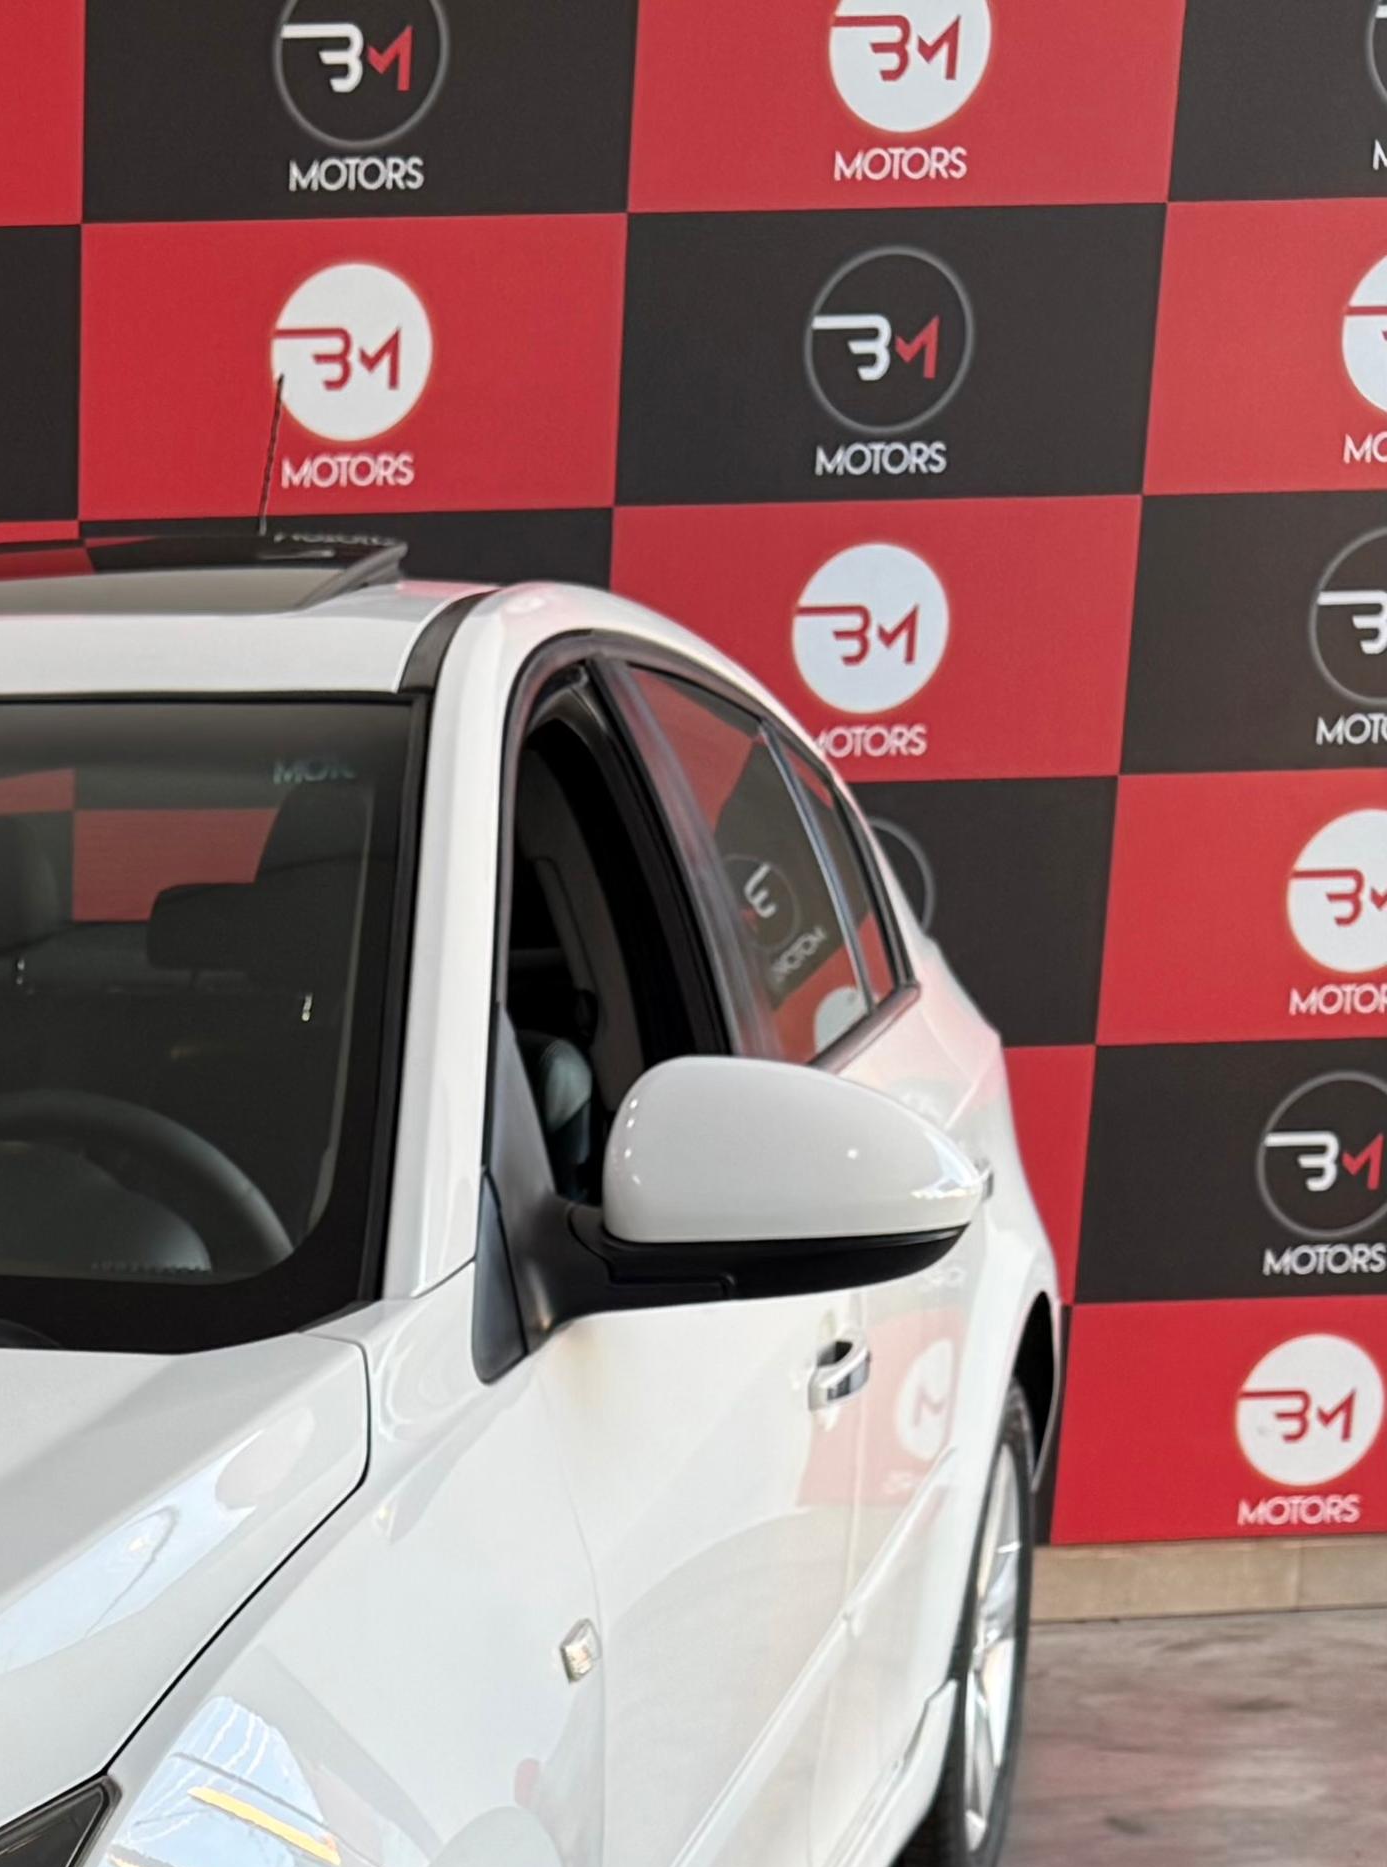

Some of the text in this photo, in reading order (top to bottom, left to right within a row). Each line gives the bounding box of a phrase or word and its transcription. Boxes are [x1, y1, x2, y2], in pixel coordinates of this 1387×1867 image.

[288, 157, 424, 193] MOTORS
[833, 146, 968, 182] MOTORS
[281, 453, 414, 490] MOTORS
[815, 441, 947, 476] MOTORS
[1317, 590, 1387, 654] B
[1316, 713, 1387, 745] MOT
[1289, 983, 1387, 1016] MOTO
[1264, 1243, 1387, 1276] MOTORS
[1238, 1495, 1361, 1526] MOTORS
